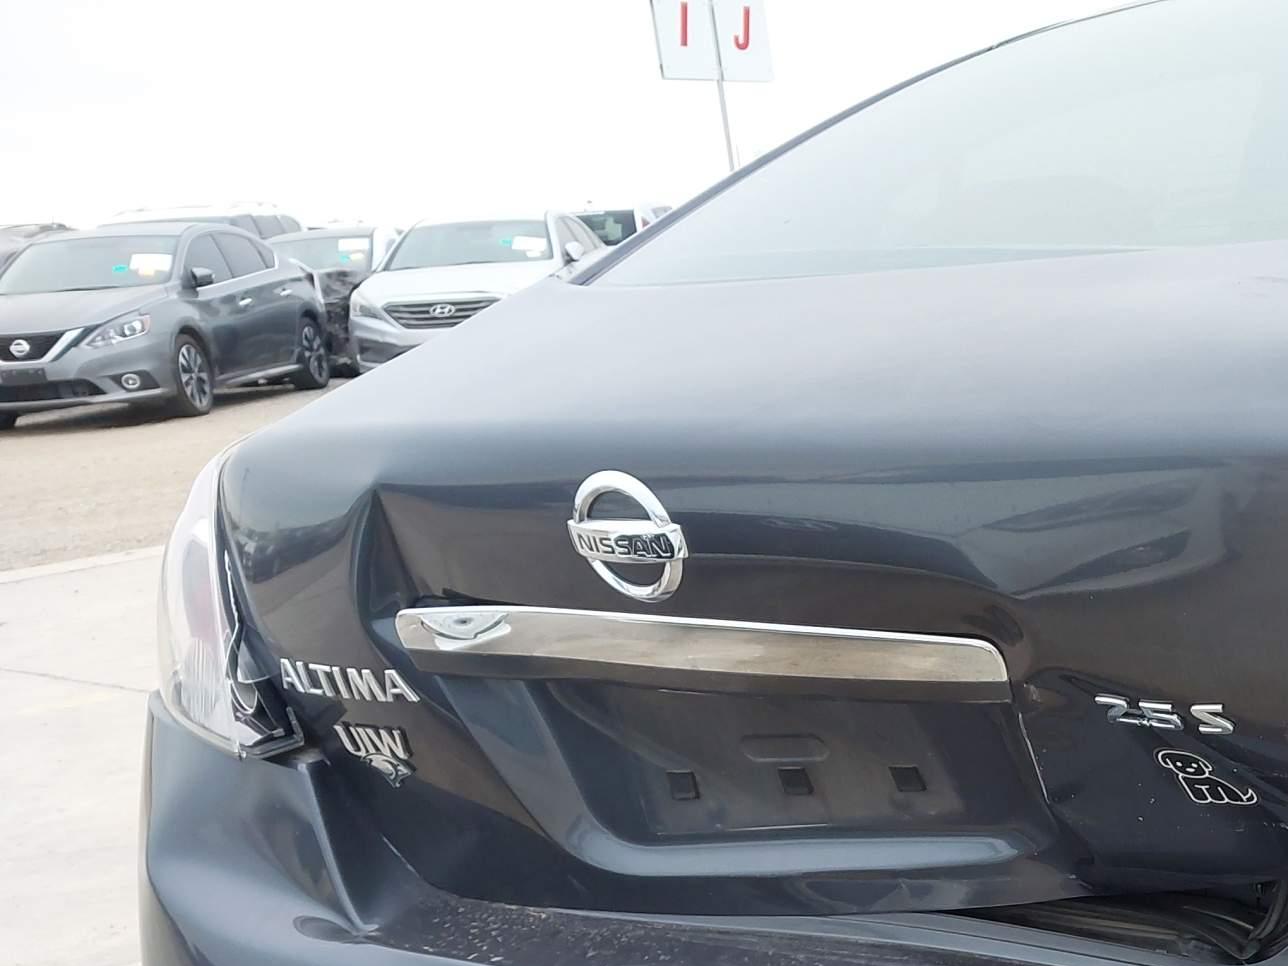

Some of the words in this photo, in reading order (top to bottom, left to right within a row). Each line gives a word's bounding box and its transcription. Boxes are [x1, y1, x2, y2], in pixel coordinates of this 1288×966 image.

[680, 2, 688, 47] I
[734, 6, 751, 50] J
[577, 534, 672, 558] NISSAN
[280, 657, 421, 703] ALTIMA
[1190, 704, 1236, 735] S
[333, 722, 411, 760] UIW
